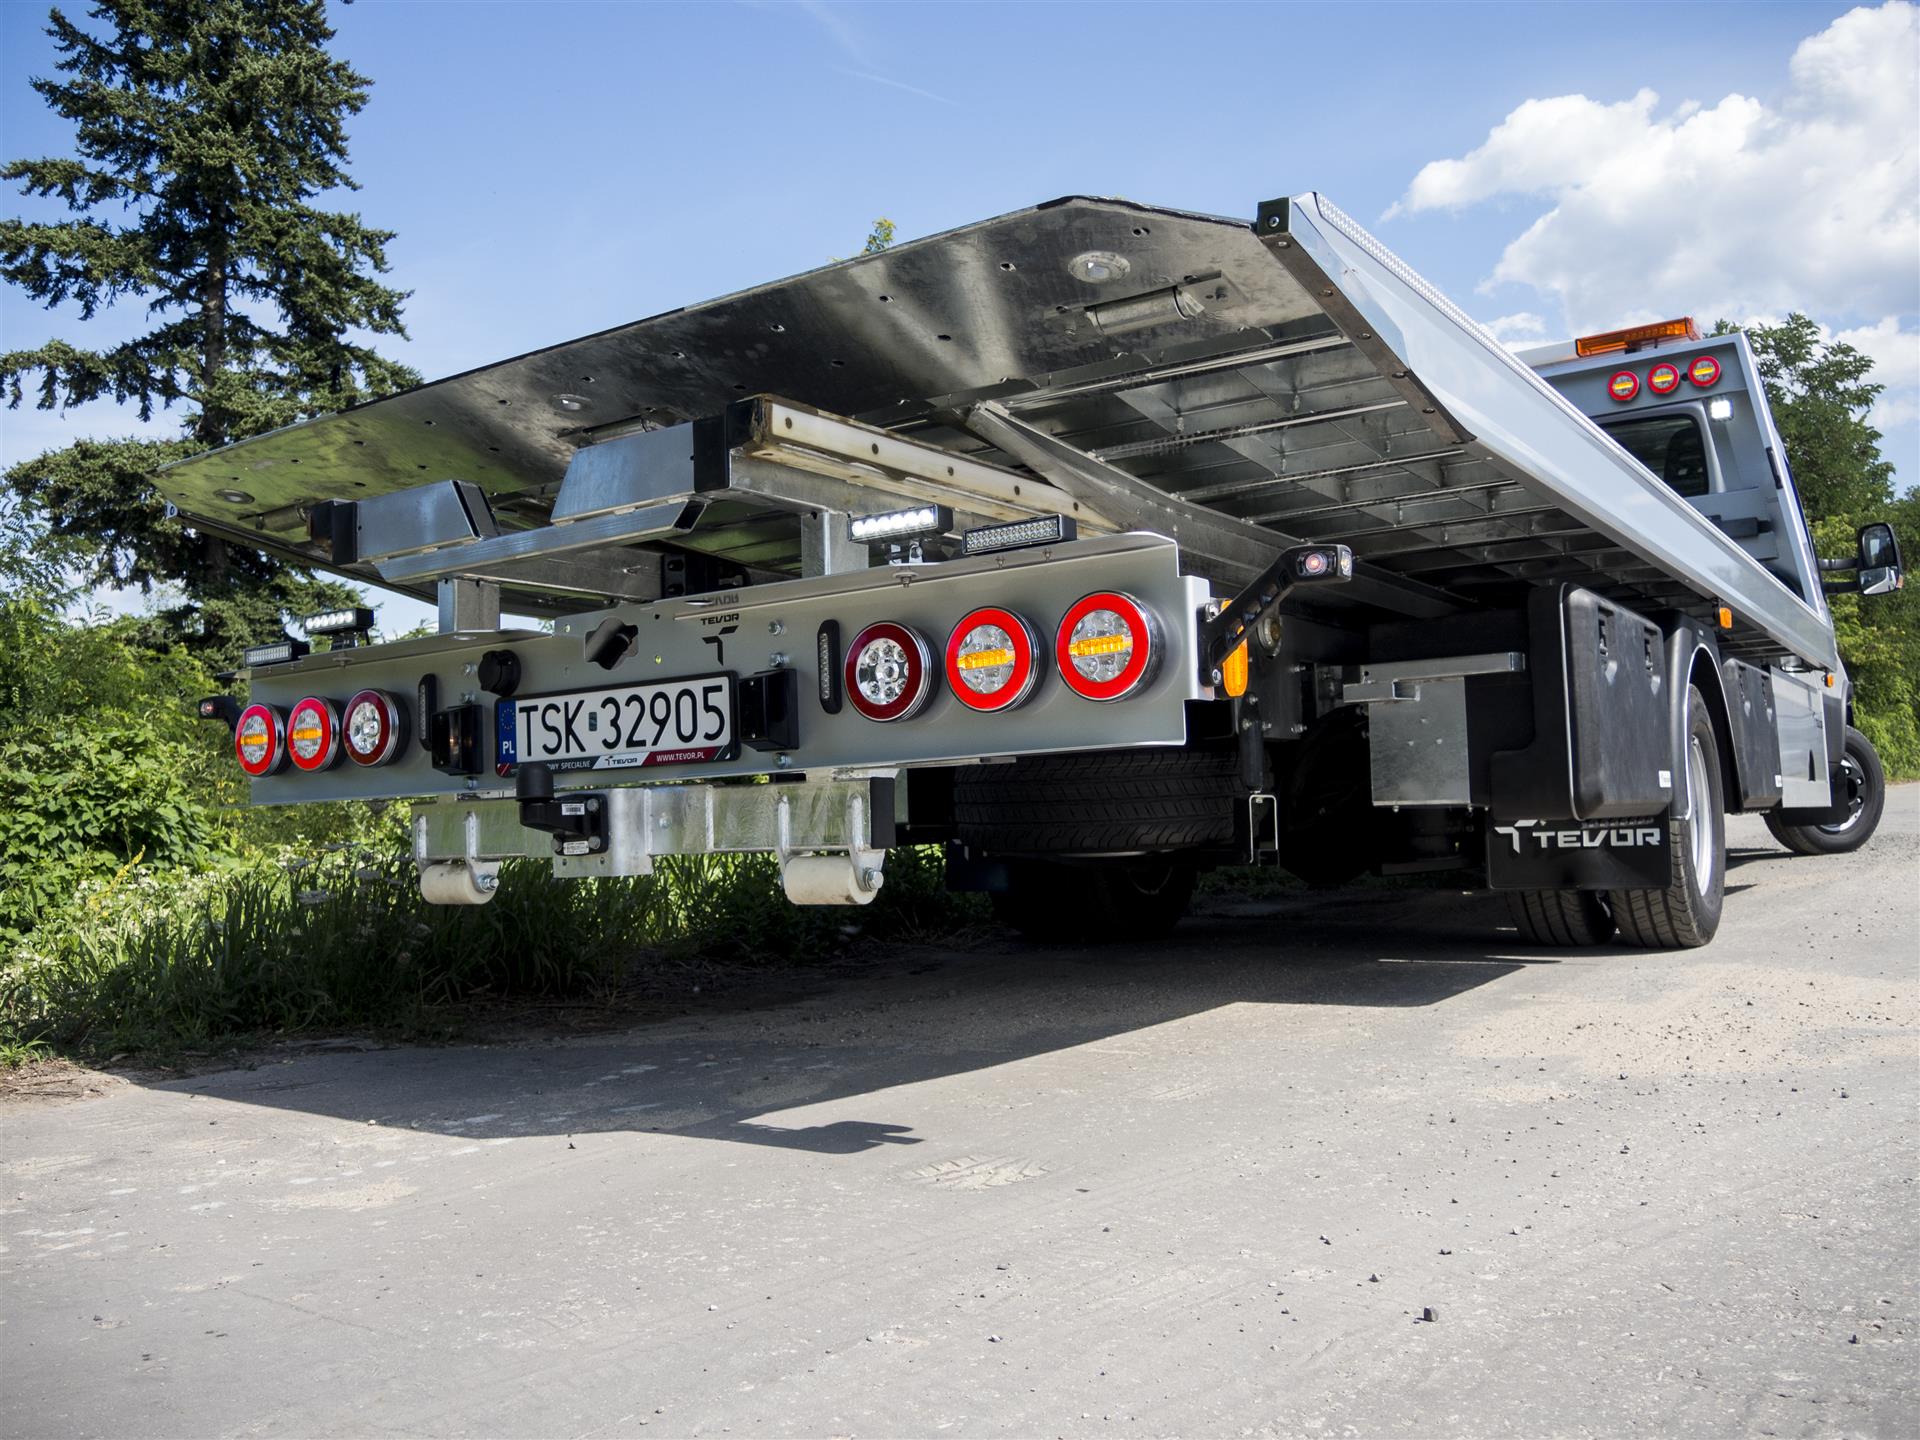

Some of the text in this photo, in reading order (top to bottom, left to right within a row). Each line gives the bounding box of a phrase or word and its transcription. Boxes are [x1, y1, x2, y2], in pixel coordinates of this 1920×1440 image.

[700, 613, 740, 626] TEVOR
[518, 685, 726, 757] TSK 32905
[502, 741, 515, 755] PL
[613, 757, 638, 766] TEVOR
[656, 752, 705, 762] WWW.TEVOR.PL
[1532, 828, 1661, 849] TEVOR
